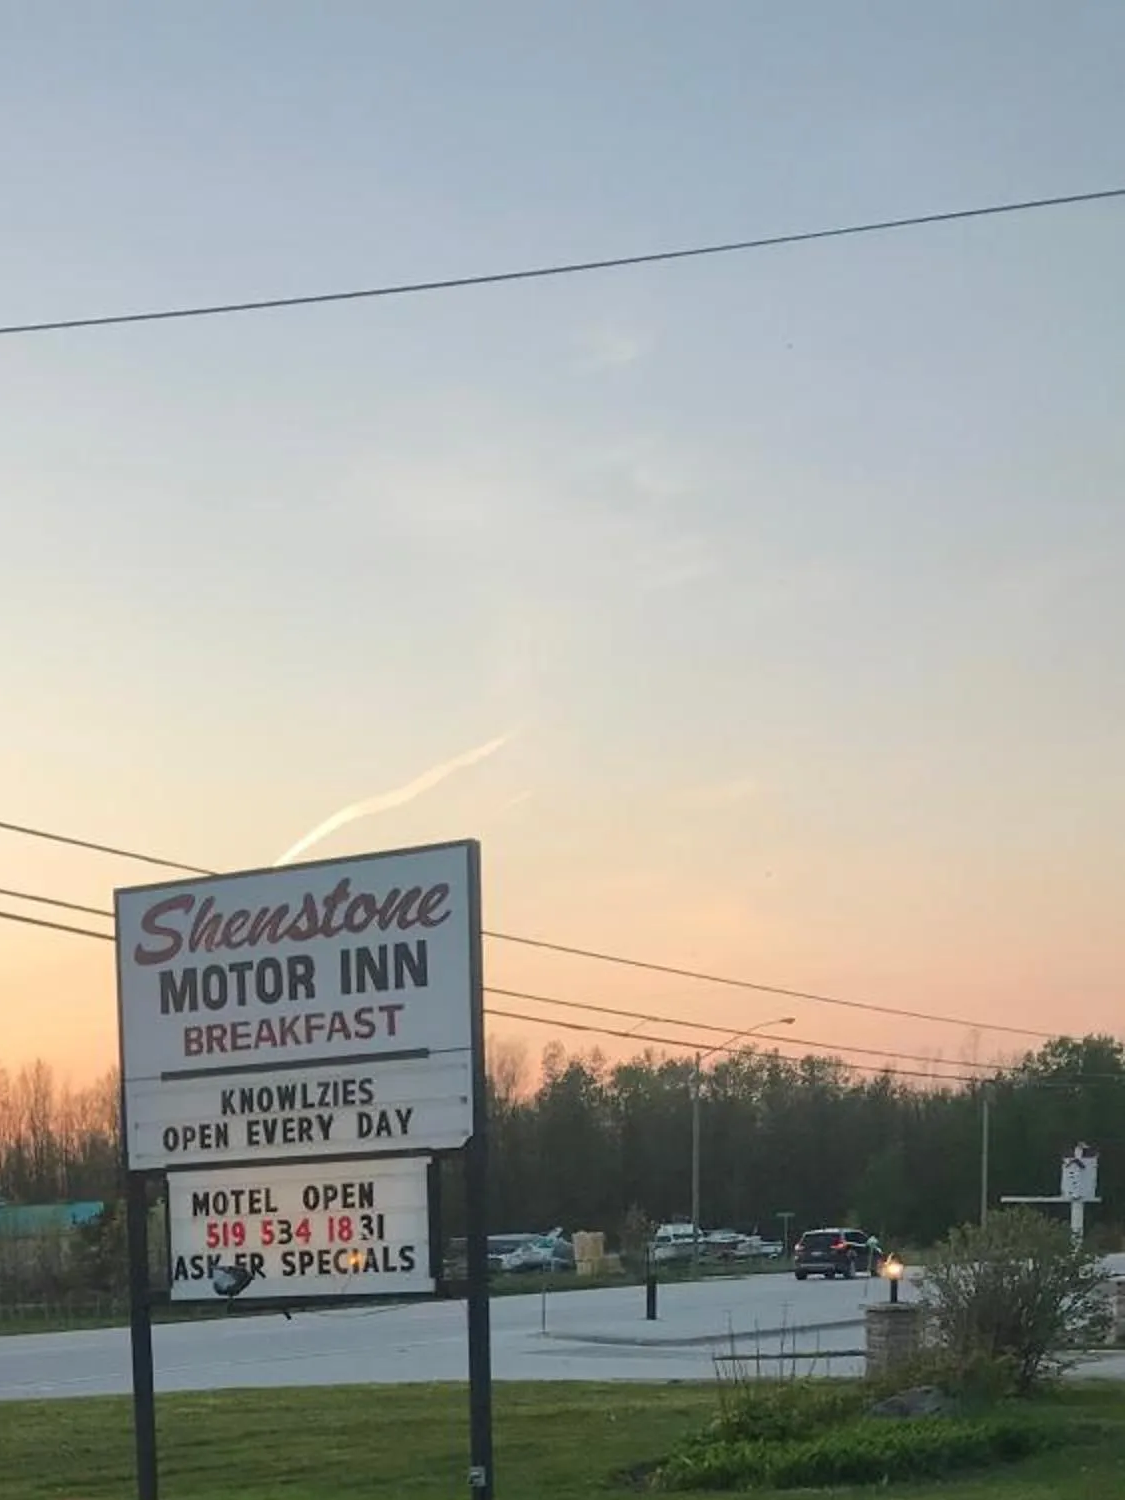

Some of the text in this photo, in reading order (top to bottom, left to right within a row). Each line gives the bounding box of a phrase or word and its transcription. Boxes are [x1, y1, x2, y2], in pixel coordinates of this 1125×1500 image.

[133, 878, 452, 966] Shenstone
[159, 939, 429, 1015] MOTOR INN
[184, 1004, 405, 1057] BREAKFAST
[221, 1078, 375, 1116] KNOWLZIES
[162, 1107, 414, 1152] OPEN EVERY DAY
[192, 1181, 375, 1217] MOTEL OPEN
[206, 1213, 385, 1248] 519 534 1831
[282, 1245, 416, 1277] SPECIALS
